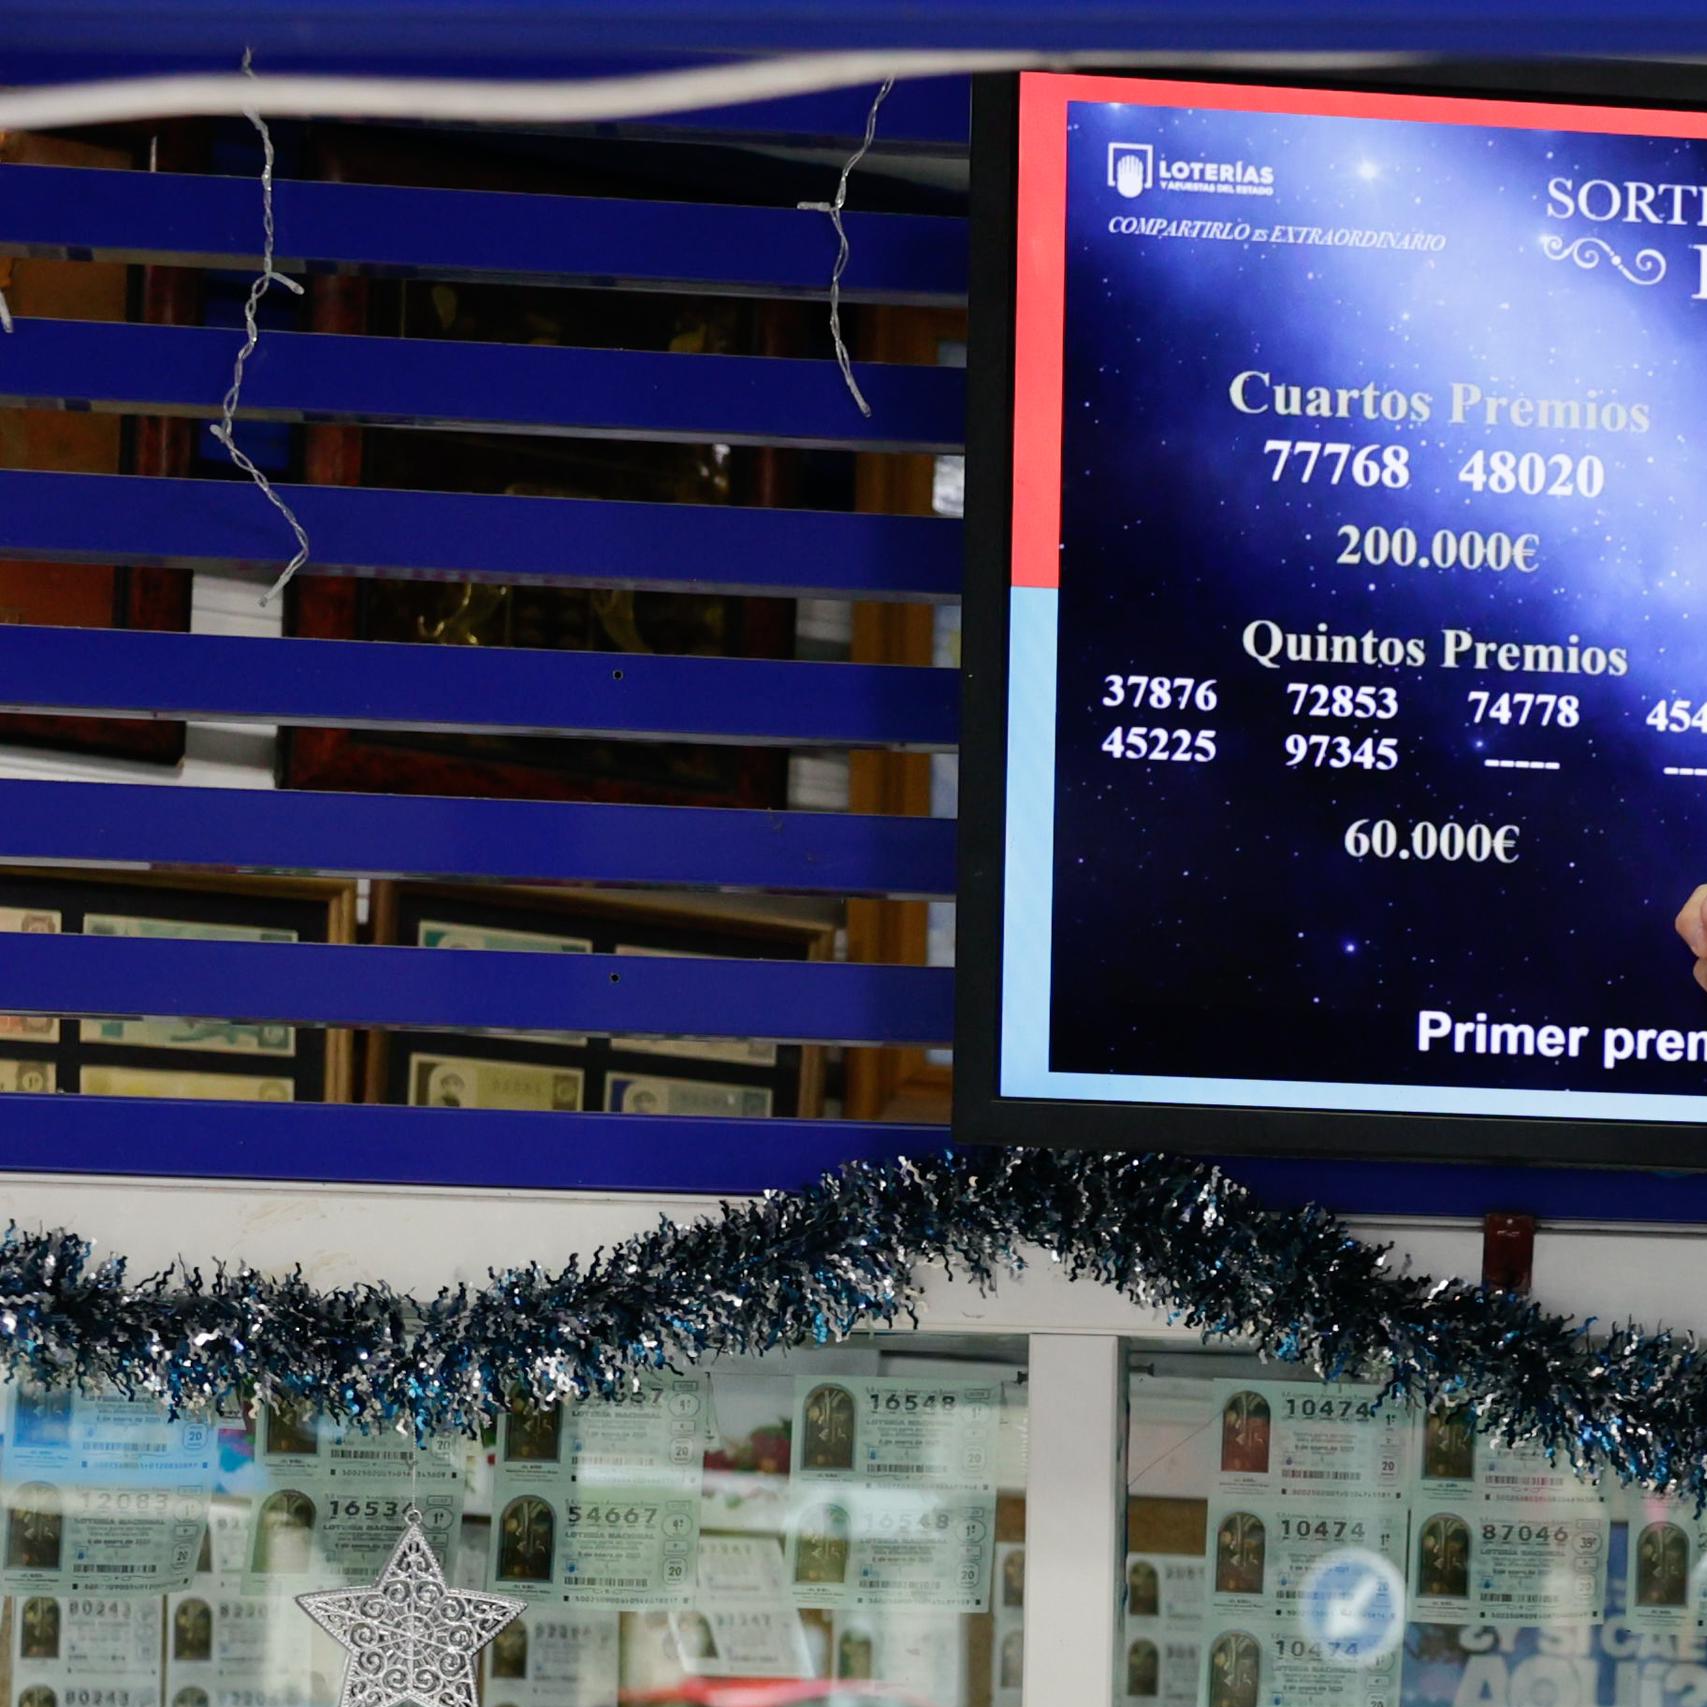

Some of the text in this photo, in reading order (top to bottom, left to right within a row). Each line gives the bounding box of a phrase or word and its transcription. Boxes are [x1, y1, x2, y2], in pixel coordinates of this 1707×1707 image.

[1160, 160, 1275, 185] LOTERÍAS
[1108, 216, 1250, 241] COMPARTIRLO
[1270, 225, 1446, 251] EXTRAORDINARIO
[1229, 371, 1651, 434] Cuartos Premios
[1264, 440, 1604, 498] 77768 48020
[1337, 525, 1540, 572] 200.000€
[1242, 619, 1628, 677] Quintos Premios
[1103, 675, 1218, 711] 37876
[1286, 683, 1399, 719] 72853
[1467, 691, 1580, 728] 74778
[1102, 727, 1399, 771] 45225 97345
[1344, 818, 1520, 864] 60.000€
[1418, 1010, 1589, 1058] Primer
[871, 1394, 956, 1411] 16548
[1286, 1399, 1371, 1417] 10474
[80, 1493, 169, 1511] 12083
[568, 1507, 658, 1525] 54667
[1281, 1519, 1365, 1538] 10474
[1481, 1524, 1569, 1543] 87046
